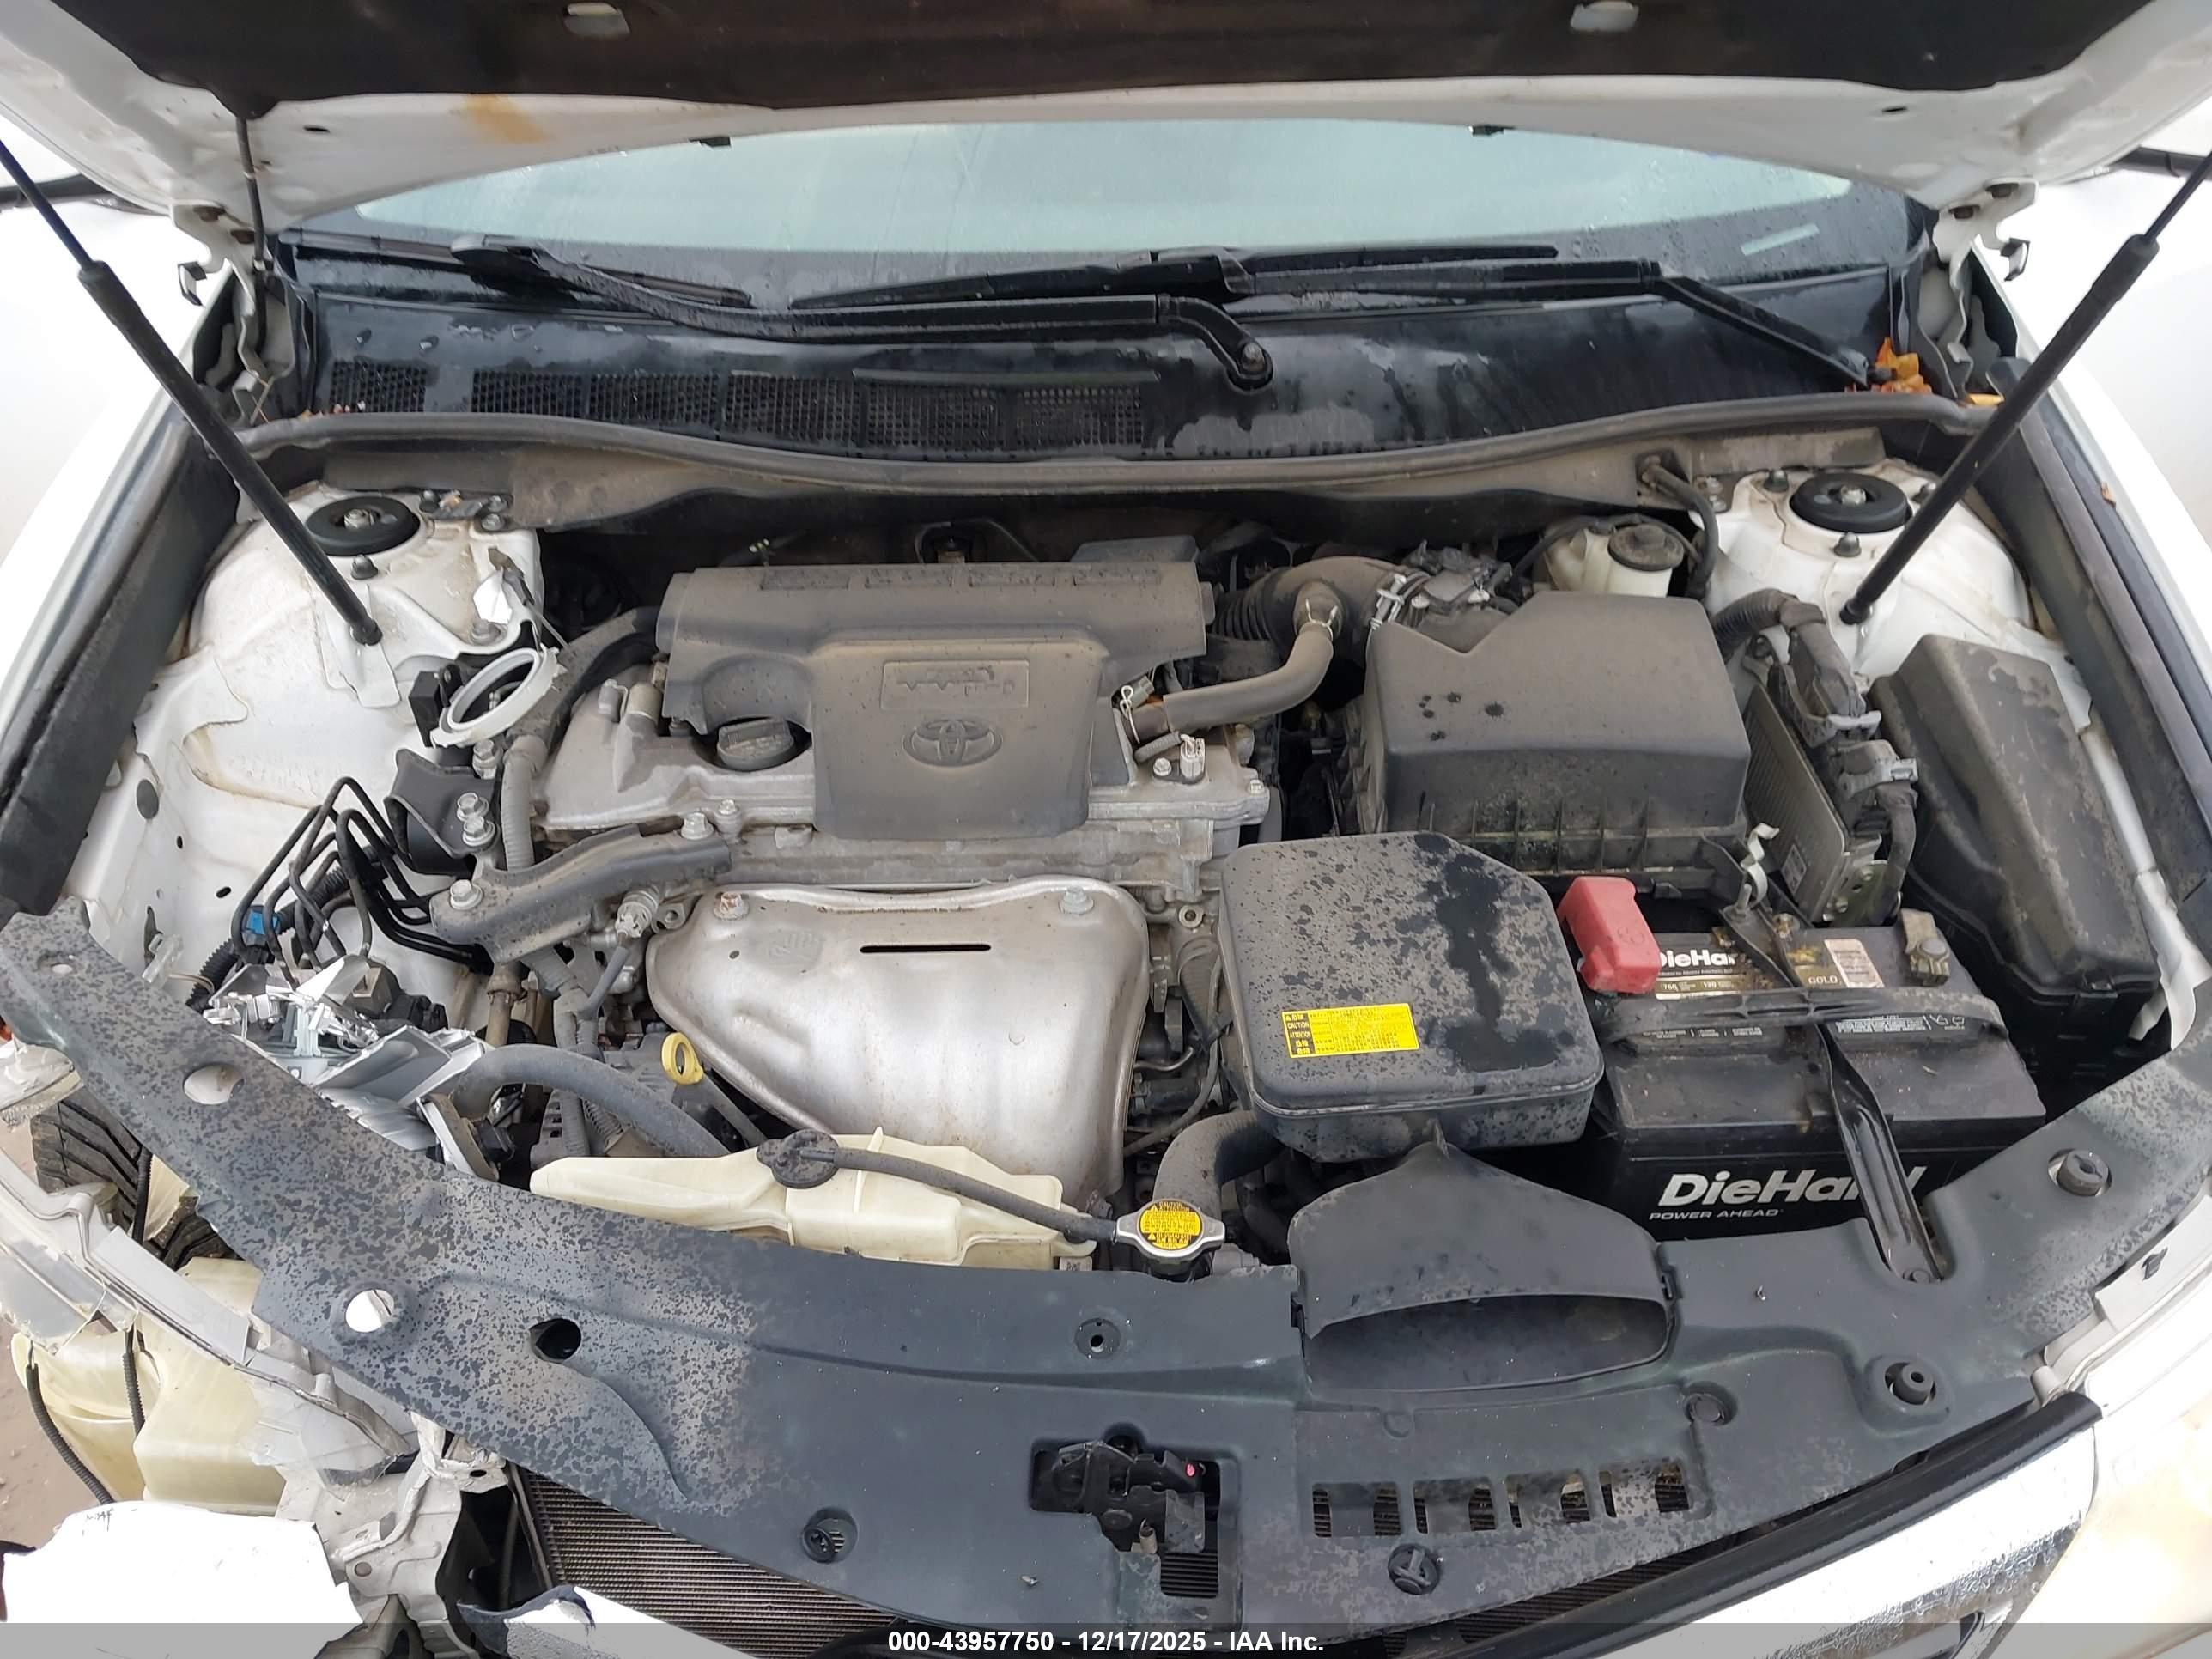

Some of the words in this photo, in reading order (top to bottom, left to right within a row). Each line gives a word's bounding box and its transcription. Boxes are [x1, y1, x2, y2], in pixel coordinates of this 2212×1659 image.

[1808, 975, 1838, 985] GOLD
[1649, 1211, 1711, 1220] POWER
[1717, 1208, 1779, 1218] AHEAD
